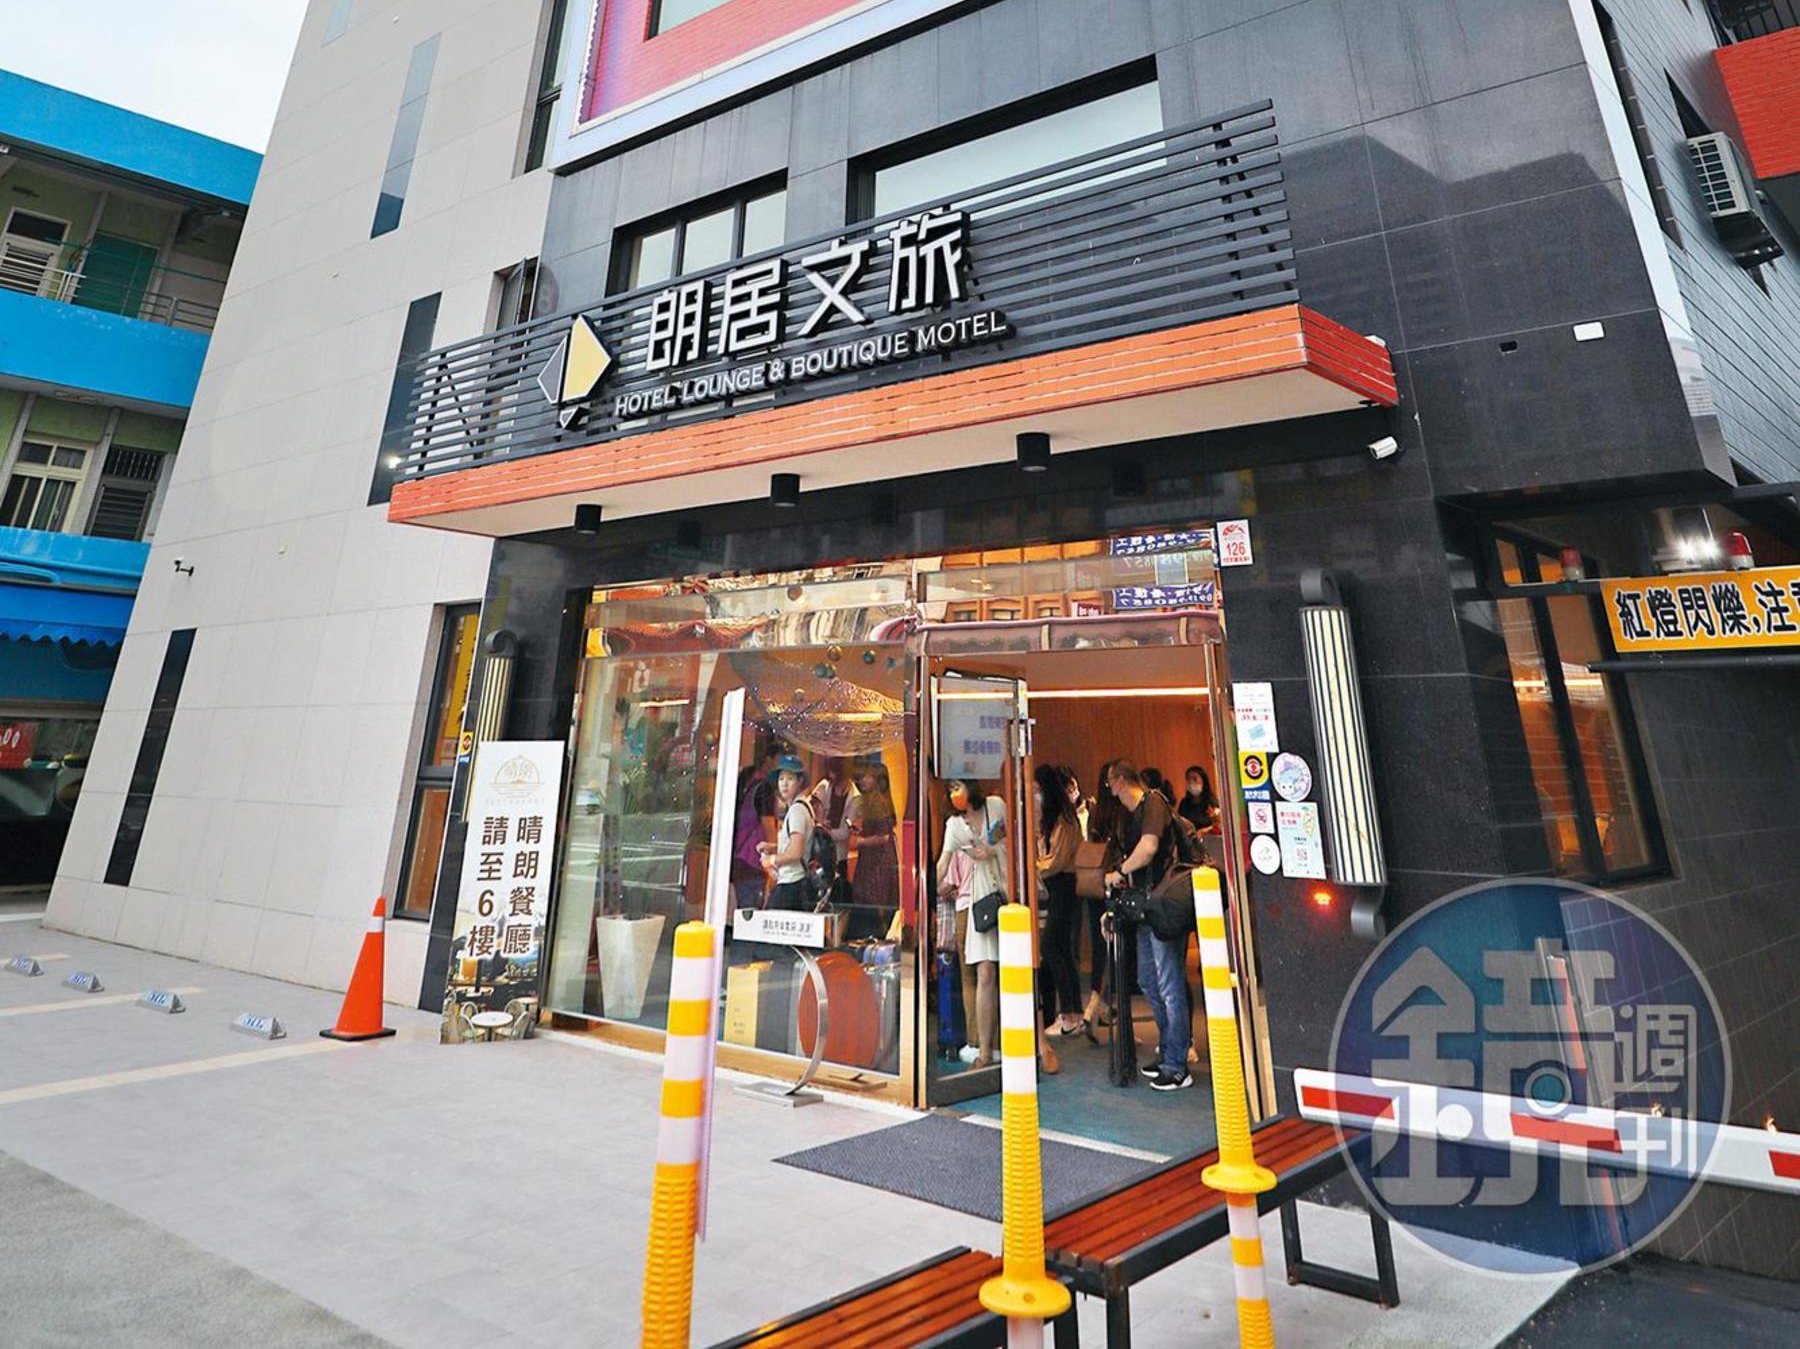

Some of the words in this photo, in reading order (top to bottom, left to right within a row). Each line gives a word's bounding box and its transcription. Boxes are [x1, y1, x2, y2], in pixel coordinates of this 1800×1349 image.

[646, 208, 964, 372] 朗居文旅
[615, 386, 676, 416] HOTEL
[681, 366, 766, 403] LOUNGE
[769, 359, 786, 381] &
[790, 335, 909, 378] BOUTIQUE
[915, 310, 1008, 351] MOTEL
[1226, 541, 1246, 556] 126
[1615, 580, 1800, 640] 紅燈閃爍,注
[467, 816, 510, 957] 請至6樓
[503, 815, 543, 954] 晴朗餐廳
